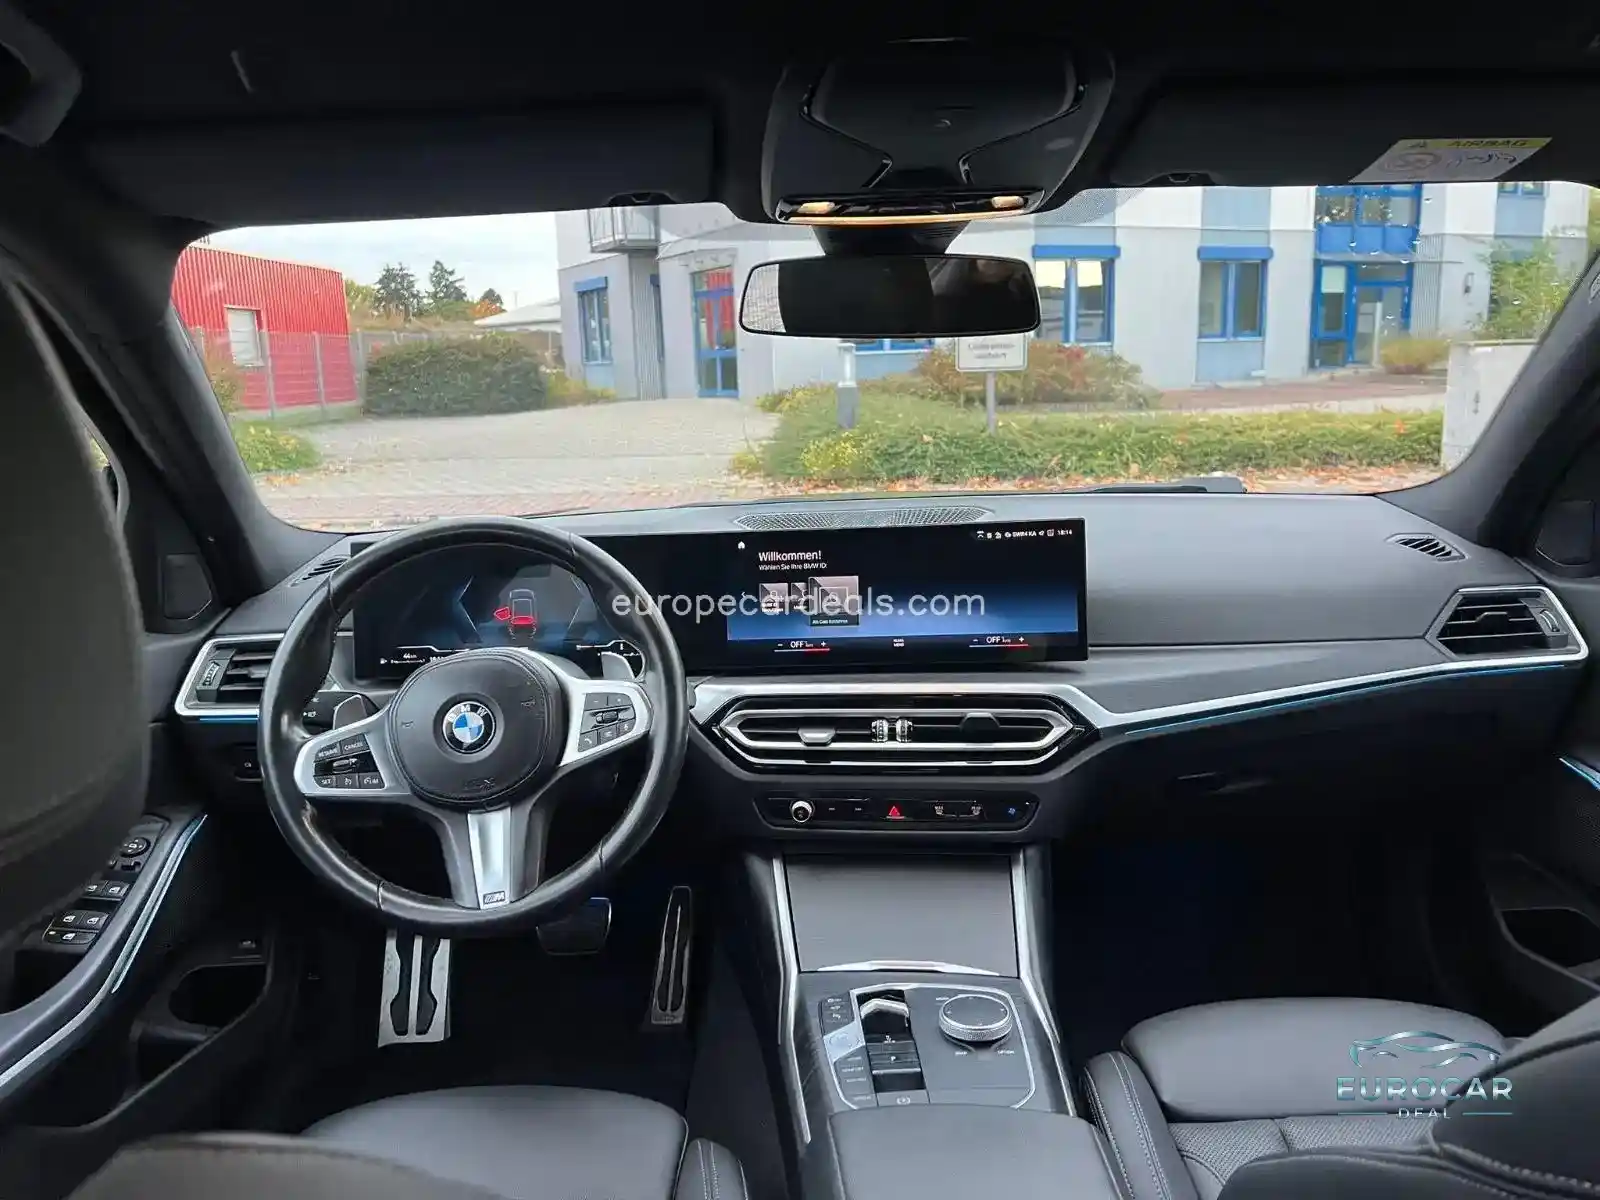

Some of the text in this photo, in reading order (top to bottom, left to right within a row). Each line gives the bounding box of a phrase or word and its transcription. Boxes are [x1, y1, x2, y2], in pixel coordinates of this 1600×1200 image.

[1448, 139, 1530, 148] AIRBAG
[758, 550, 822, 561] Willkommen!
[790, 640, 804, 648] OFF
[447, 703, 489, 723] BMW
[344, 742, 364, 750] CANCEL
